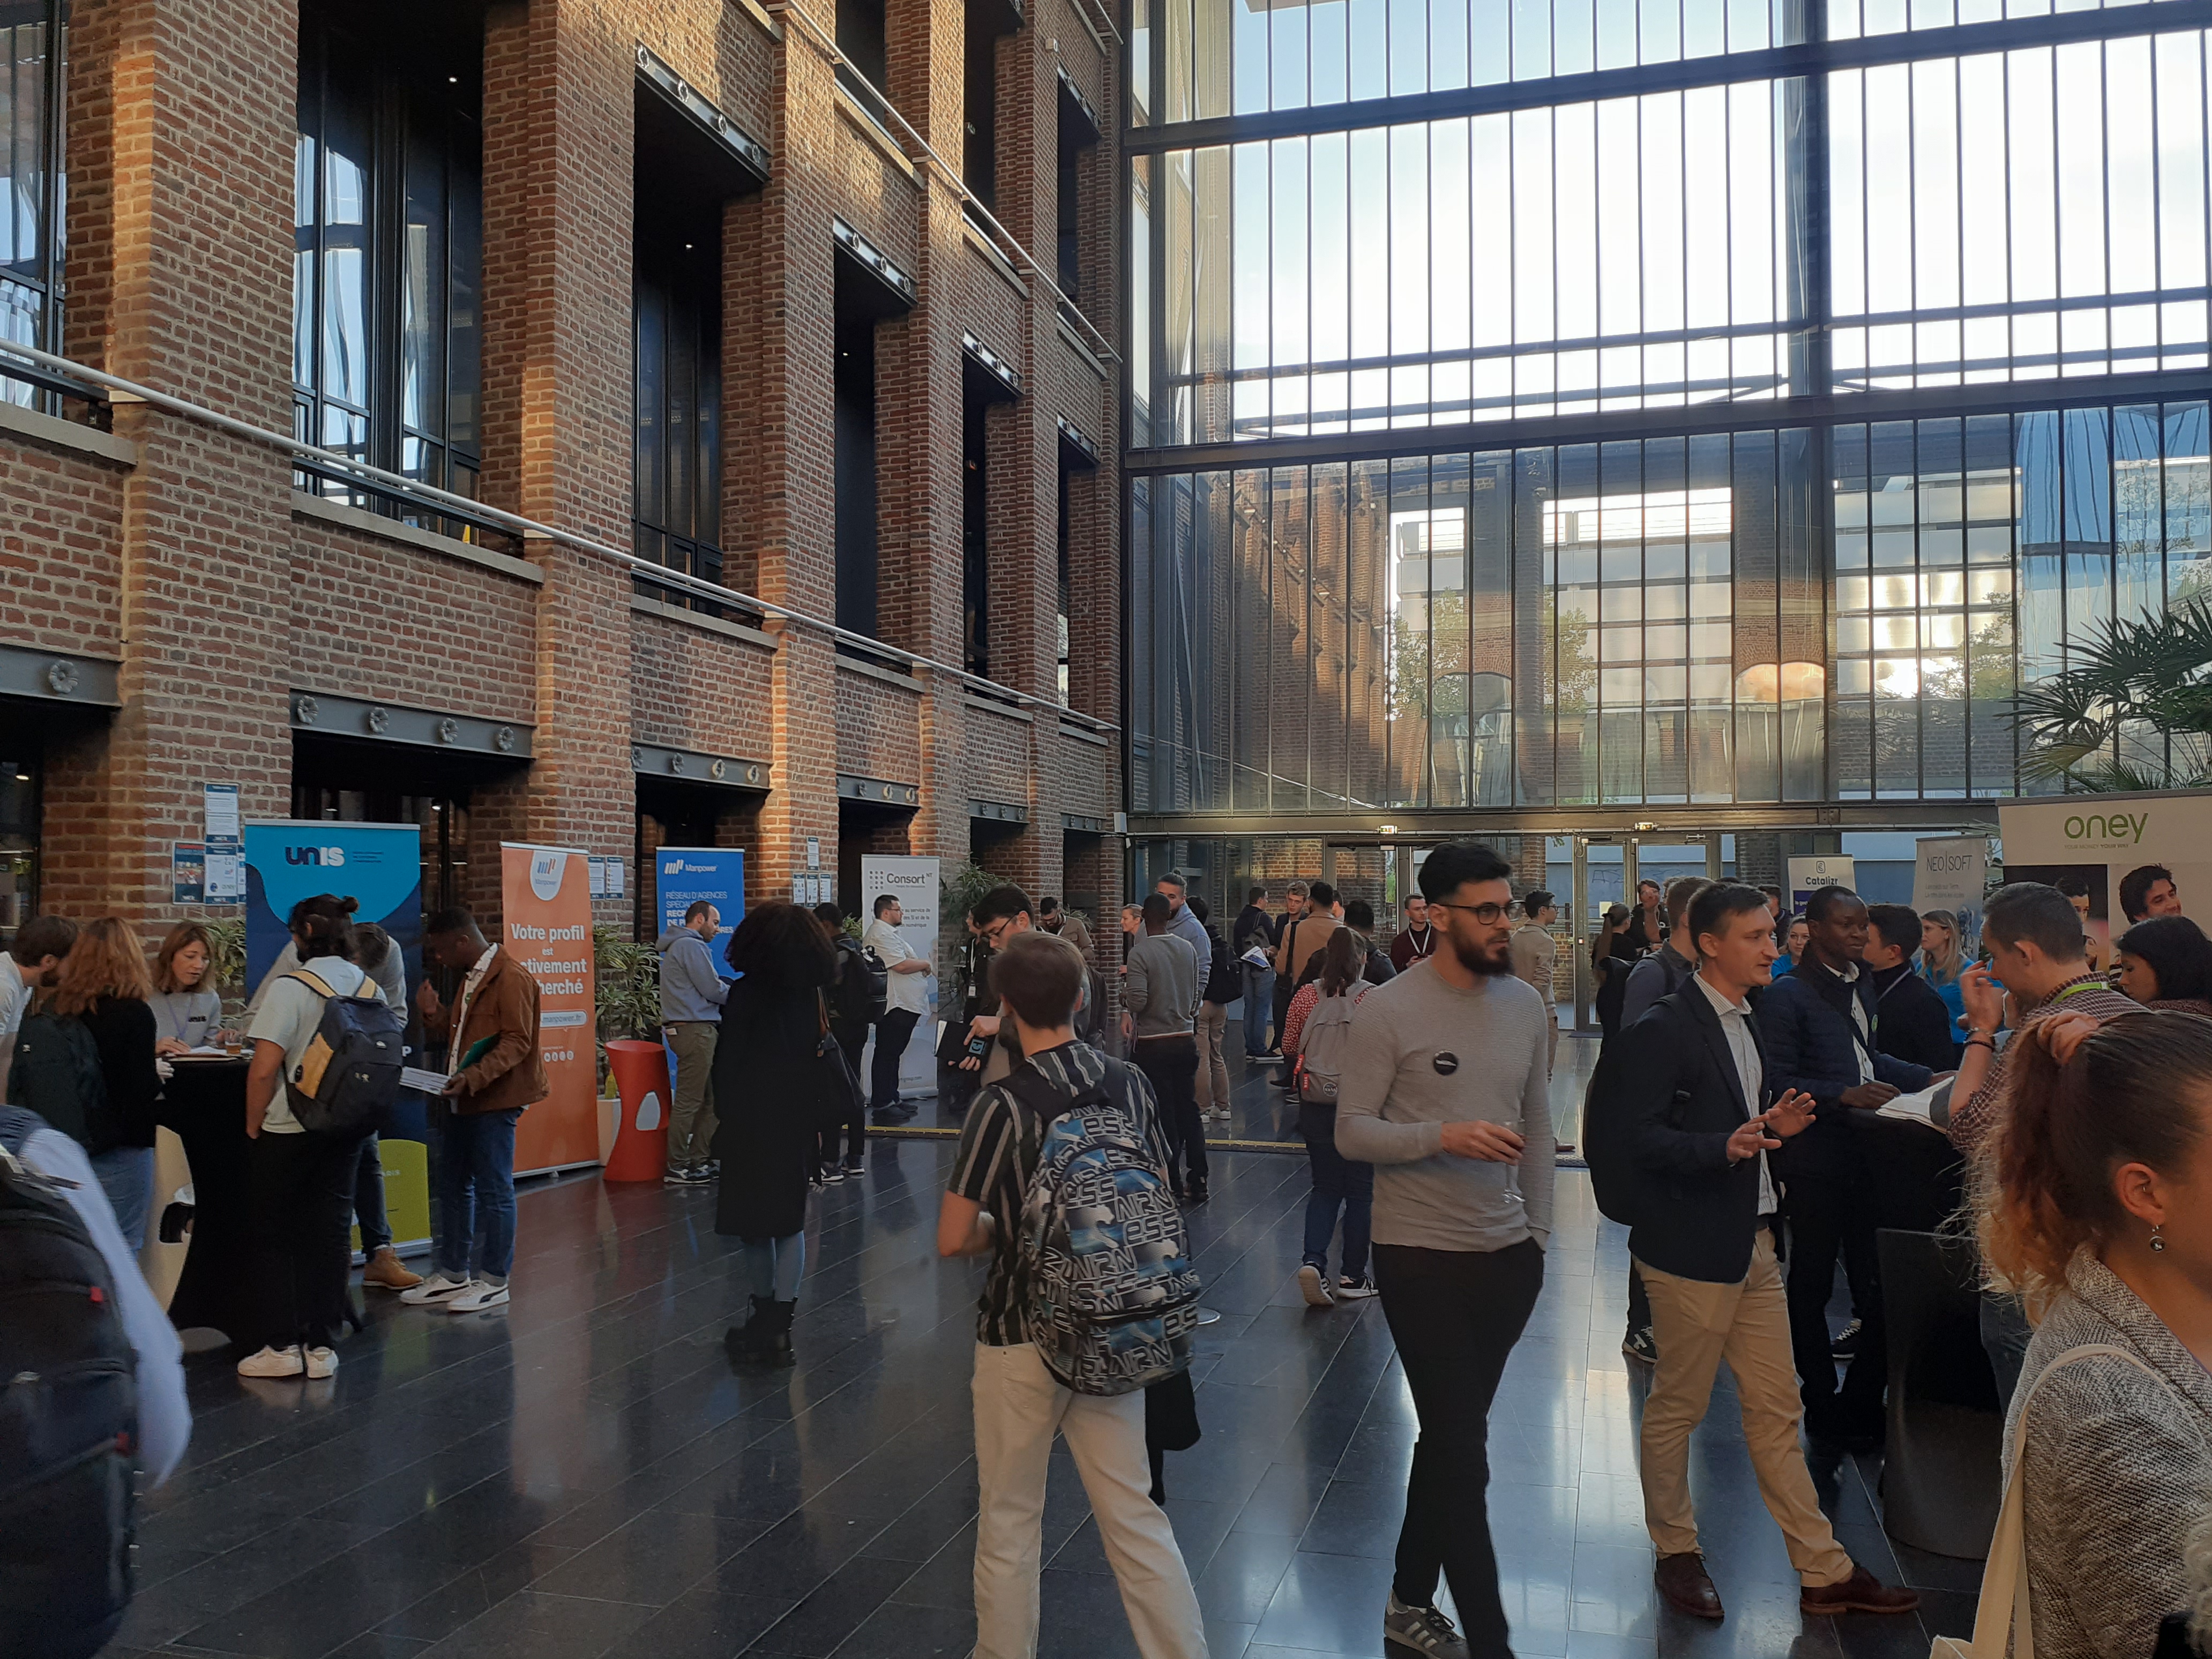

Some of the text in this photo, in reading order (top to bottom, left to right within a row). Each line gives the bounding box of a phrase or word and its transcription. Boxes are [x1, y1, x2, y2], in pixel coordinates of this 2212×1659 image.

[2064, 812, 2148, 843] oney
[685, 864, 718, 873] Manpower
[886, 873, 925, 884] Consort
[1805, 876, 1839, 885] Catalizr
[511, 923, 585, 944] Votre profil
[542, 947, 554, 956] est
[520, 957, 587, 974] ctivement
[536, 977, 584, 995] herché
